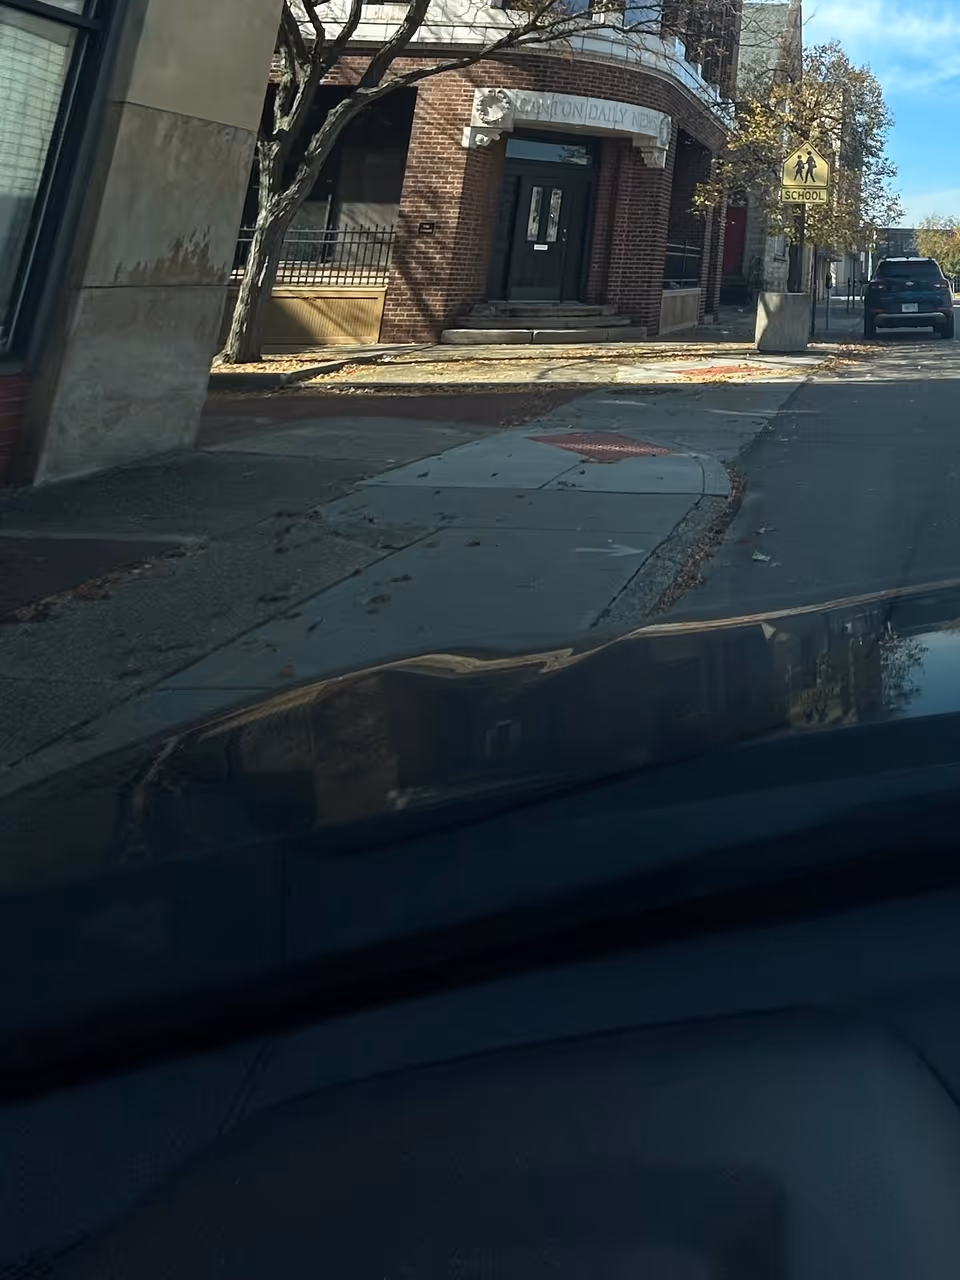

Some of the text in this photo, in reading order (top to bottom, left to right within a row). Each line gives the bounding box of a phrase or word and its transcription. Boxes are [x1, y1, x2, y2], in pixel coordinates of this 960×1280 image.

[517, 96, 658, 130] CANTON DAILY NEWS
[785, 191, 824, 200] SCHOOL
